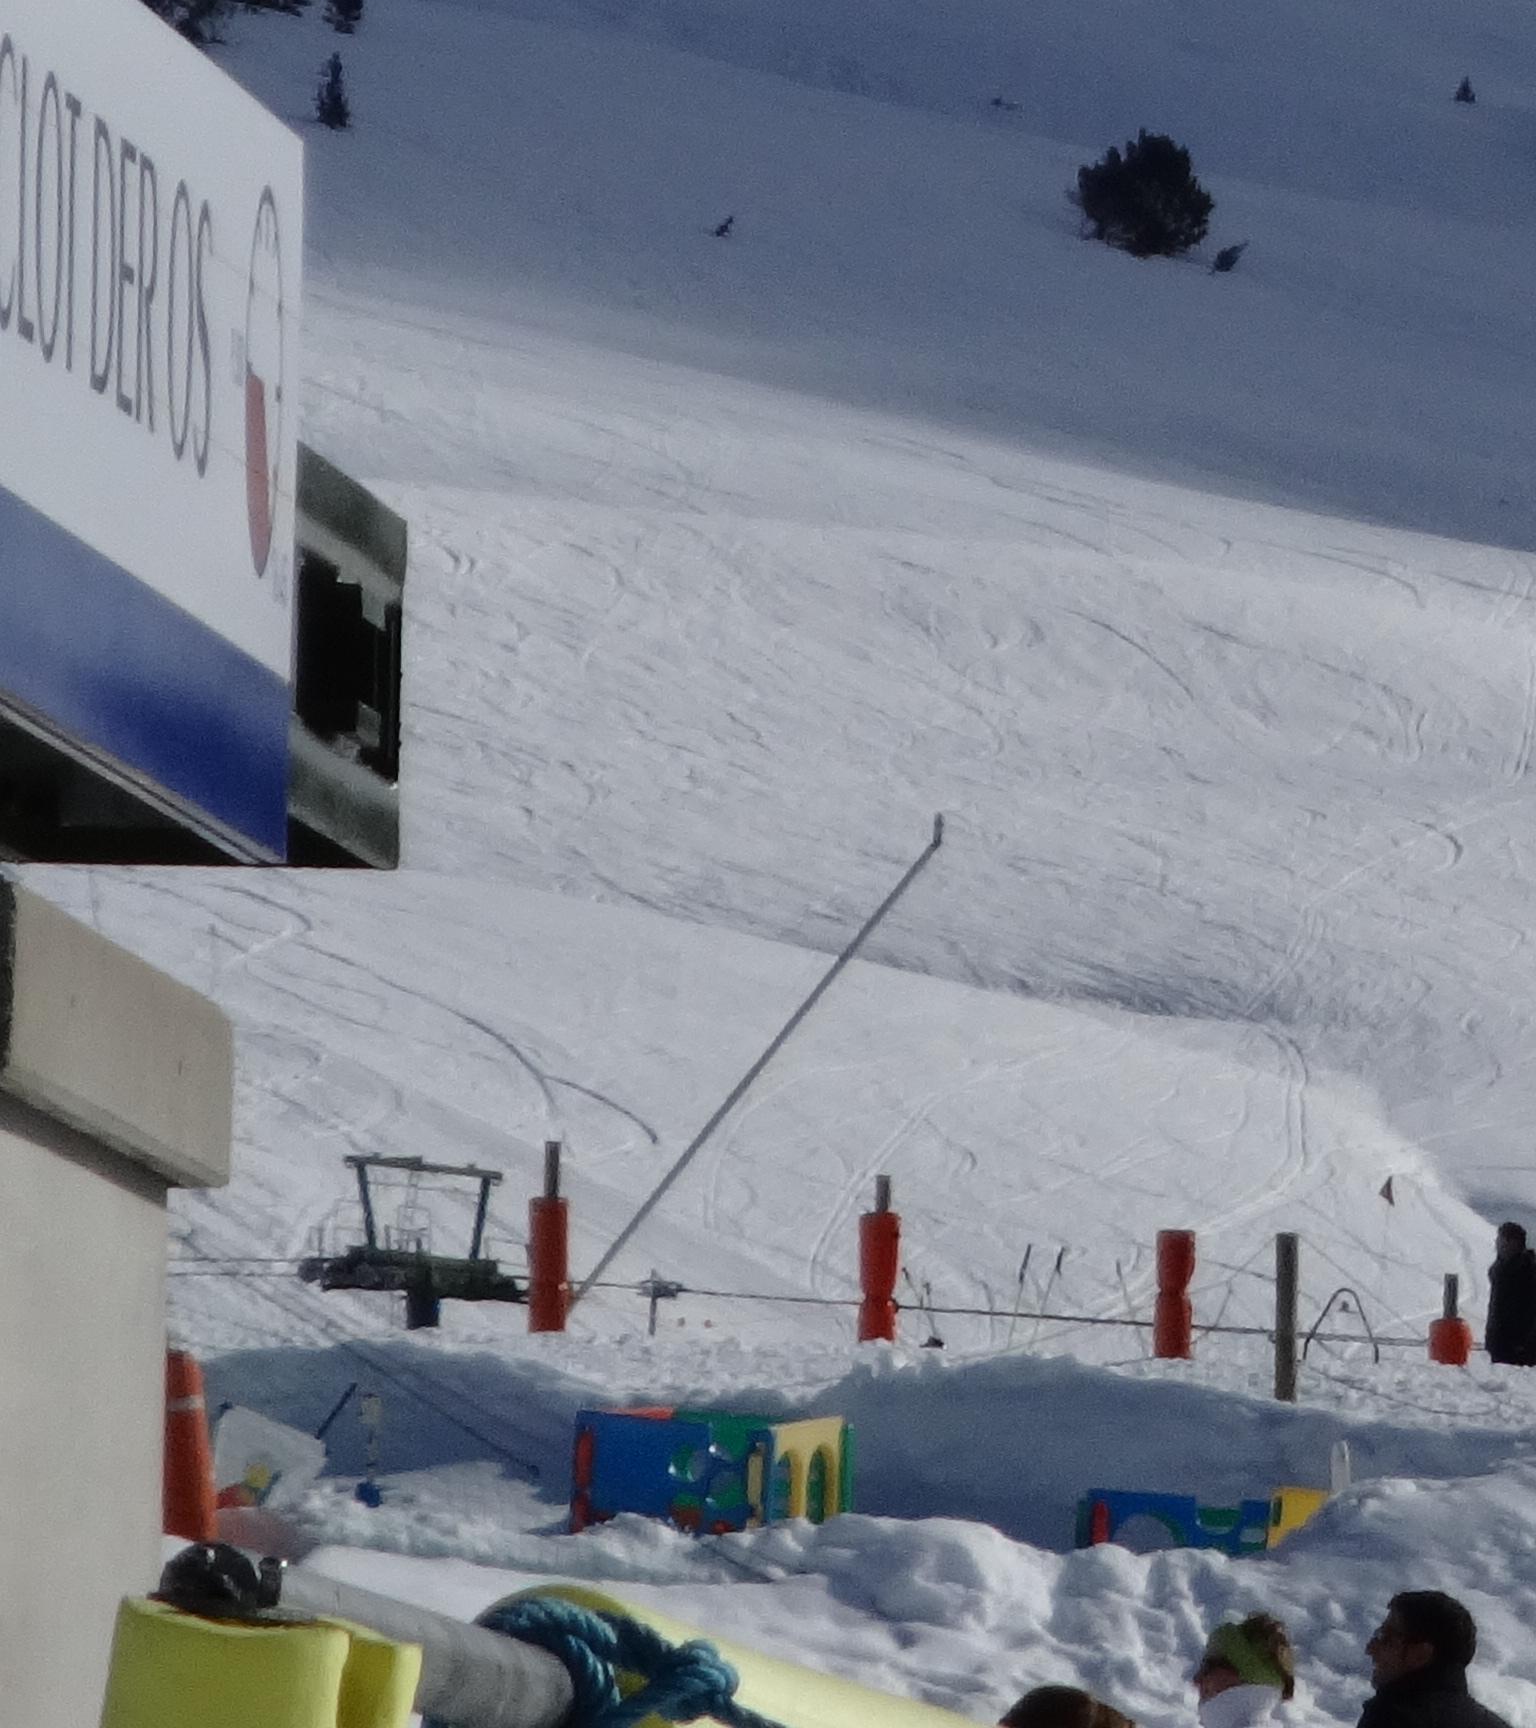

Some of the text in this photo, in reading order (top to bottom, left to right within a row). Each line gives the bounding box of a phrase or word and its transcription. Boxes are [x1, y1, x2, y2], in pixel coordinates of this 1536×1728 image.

[0, 34, 214, 478] CLOT DER OS
